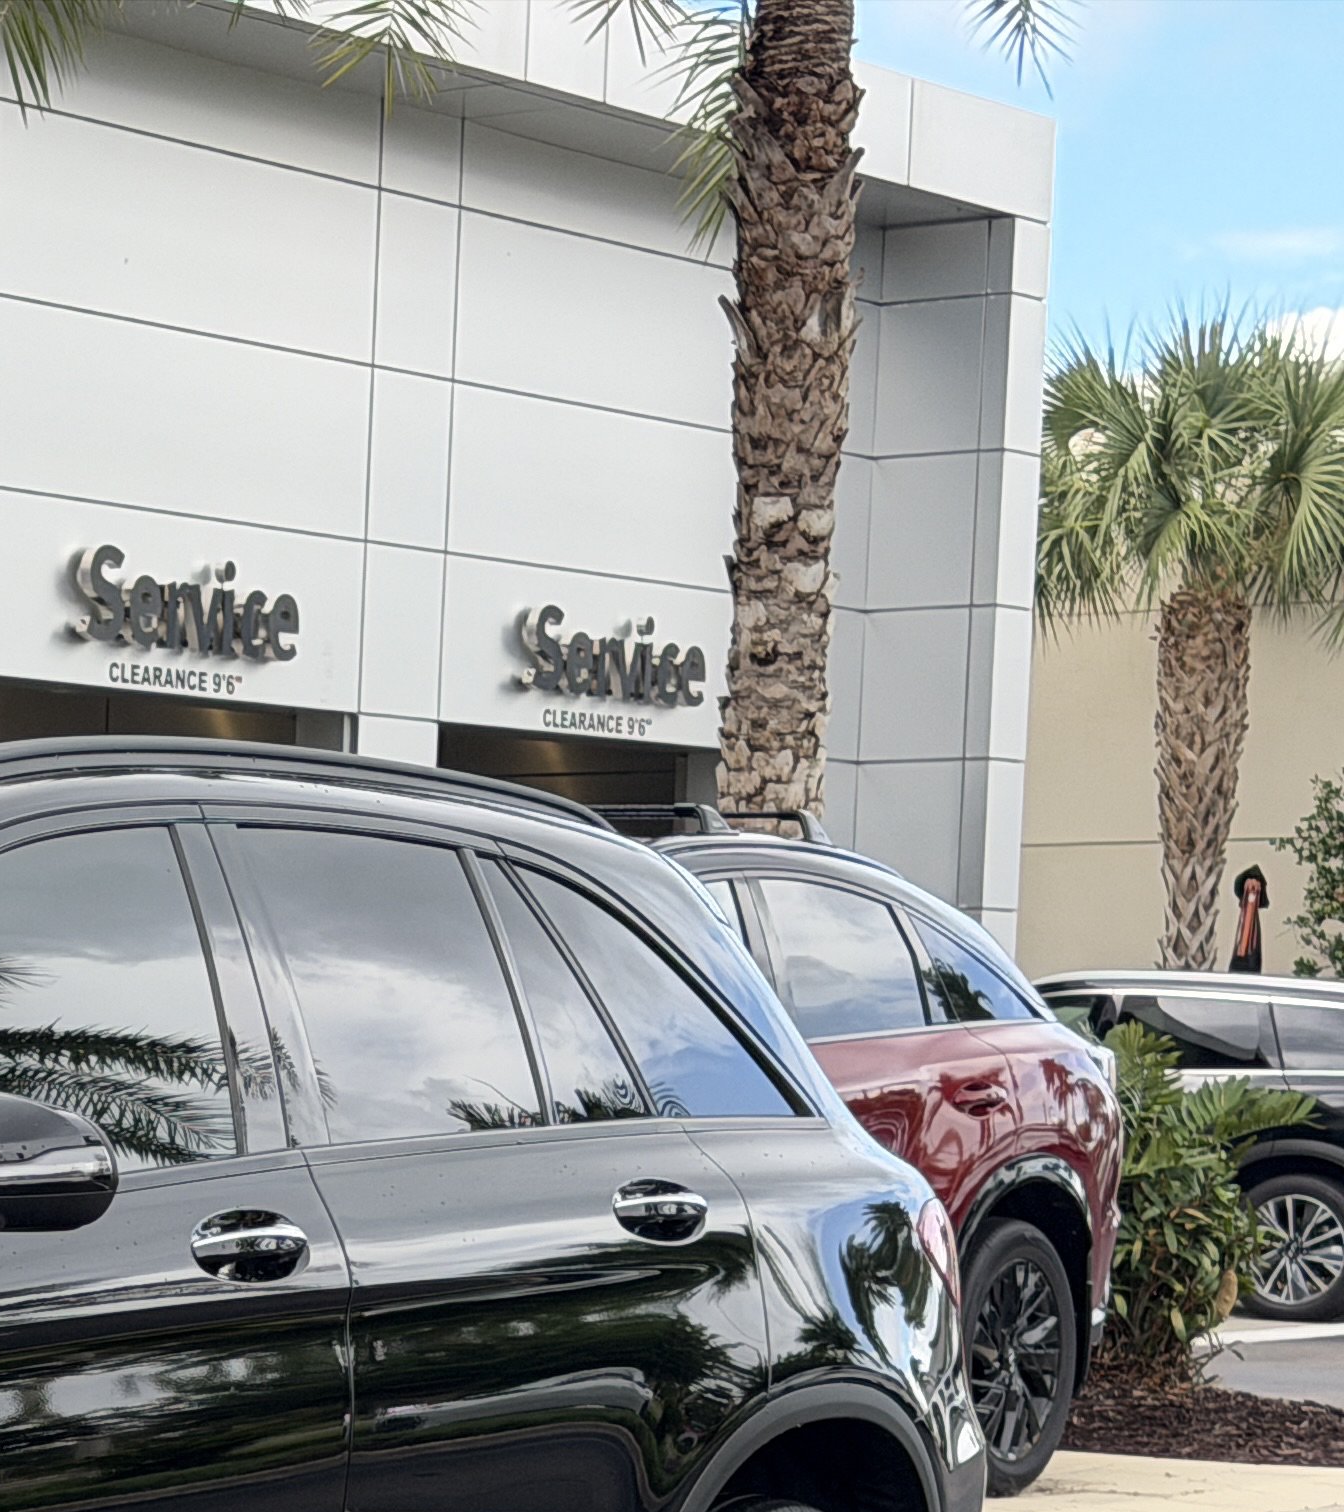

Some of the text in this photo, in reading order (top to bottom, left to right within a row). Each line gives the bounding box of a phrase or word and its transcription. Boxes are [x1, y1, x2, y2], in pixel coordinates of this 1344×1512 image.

[83, 544, 300, 662] Service
[108, 662, 208, 692] CLEARANCE
[529, 605, 706, 708] Service
[542, 708, 624, 735] CLEARANCE
